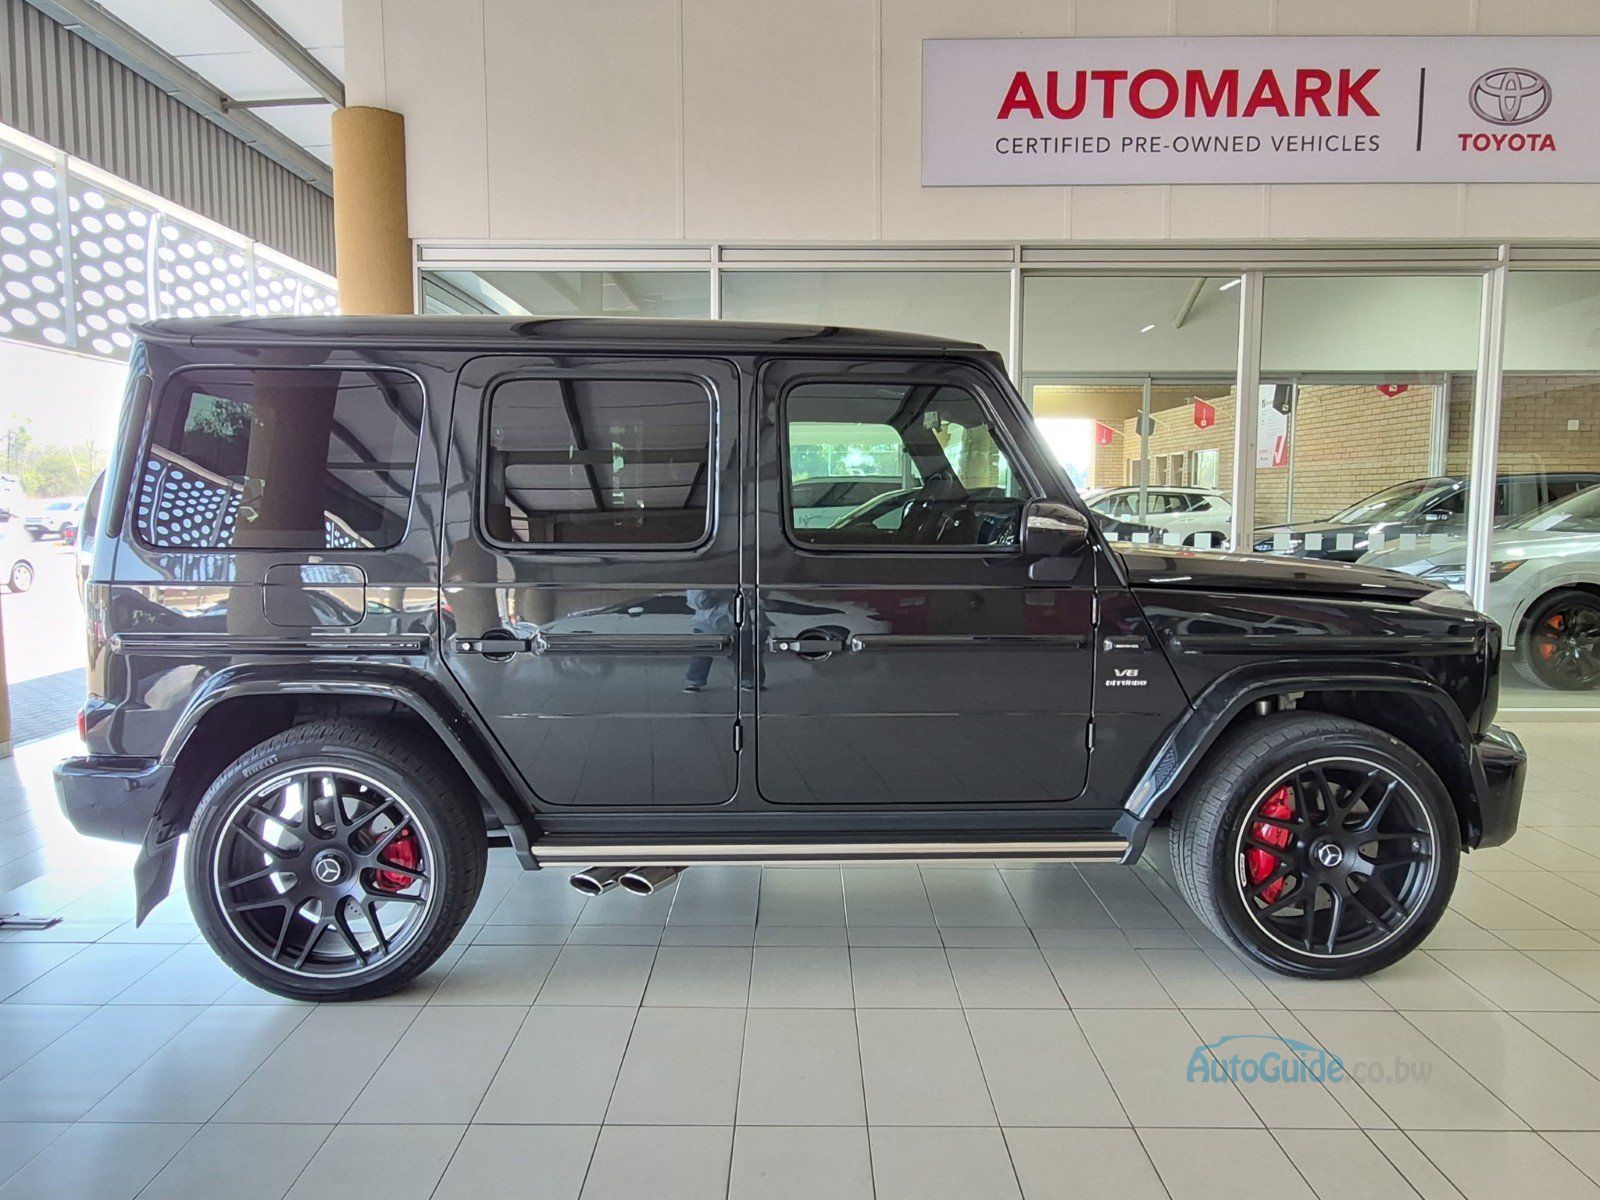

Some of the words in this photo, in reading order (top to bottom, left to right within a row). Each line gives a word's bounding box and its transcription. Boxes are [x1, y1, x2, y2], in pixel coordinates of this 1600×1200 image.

[996, 68, 1381, 120] AUTOMARK
[995, 137, 1111, 154] CERTIFIED
[1121, 136, 1261, 153] PRE-OWNED
[1271, 135, 1380, 152] VEHICLES
[1457, 133, 1556, 152] TOYOTA
[1114, 669, 1139, 677] V8
